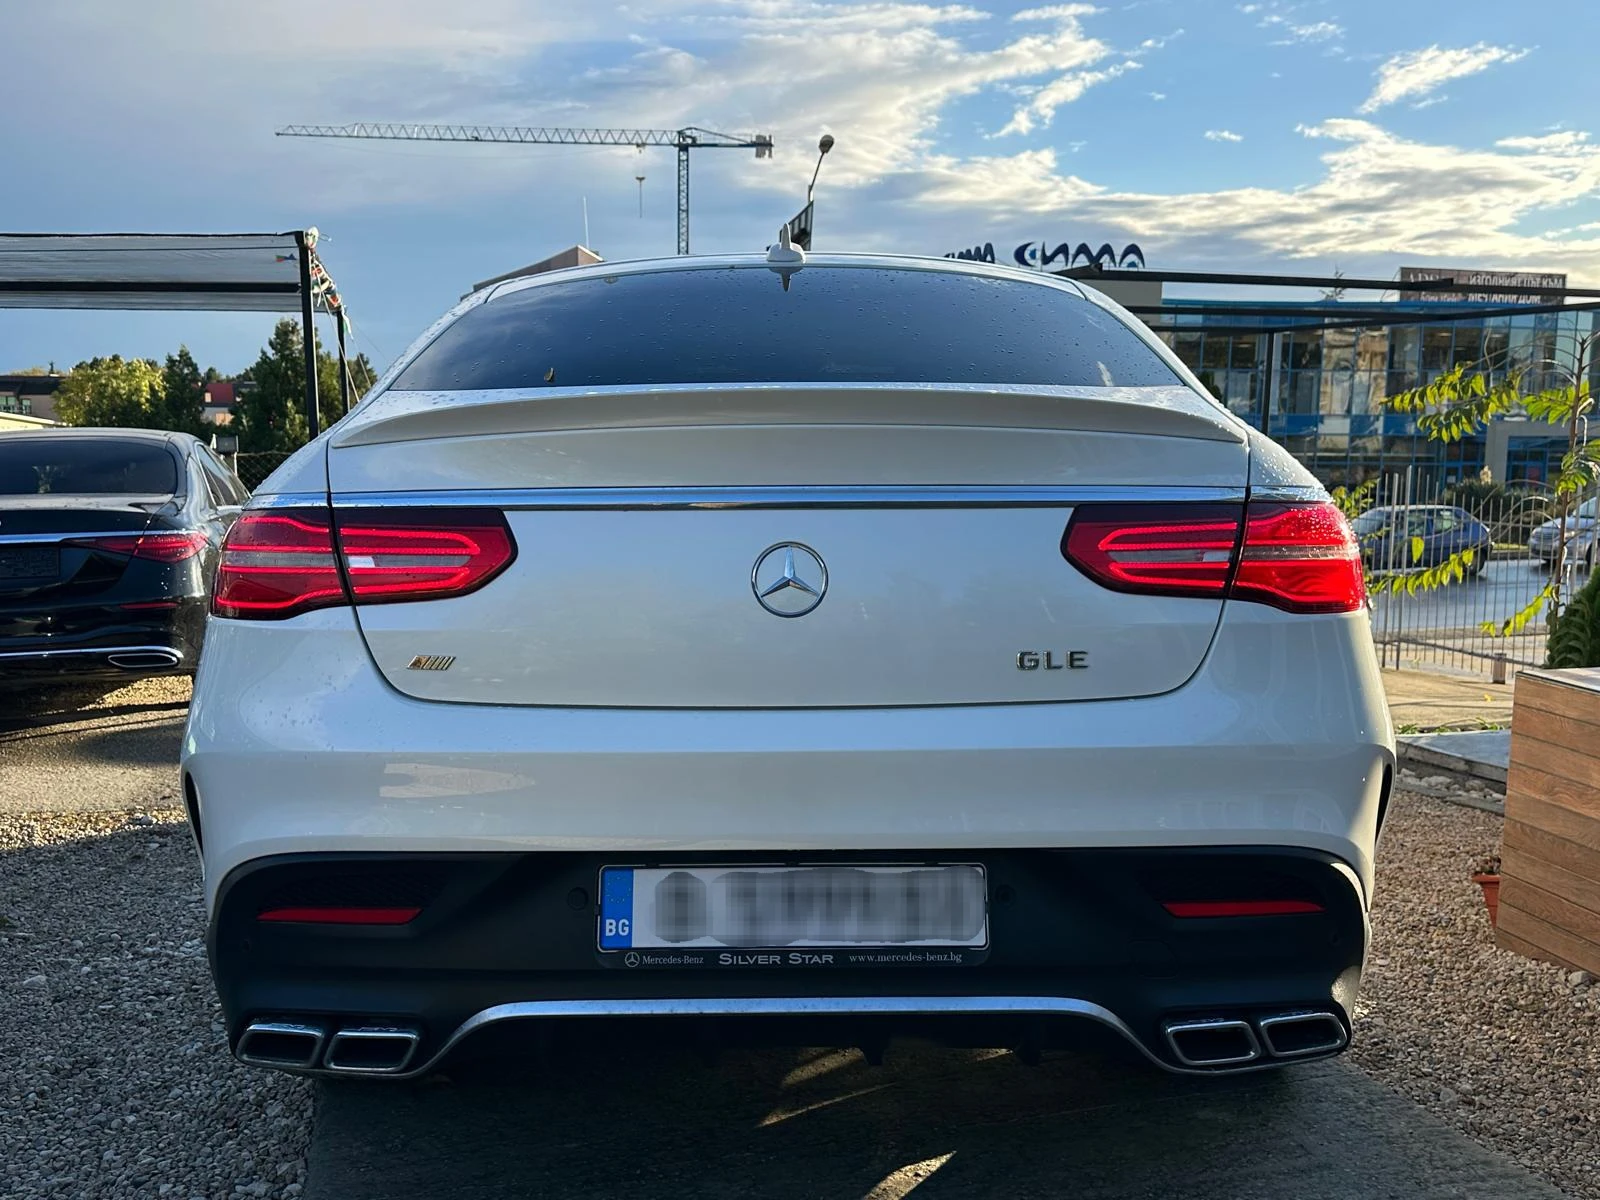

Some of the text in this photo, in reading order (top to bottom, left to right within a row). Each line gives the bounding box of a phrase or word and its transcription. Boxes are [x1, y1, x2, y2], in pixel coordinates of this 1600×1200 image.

[1016, 650, 1090, 671] GLE
[605, 918, 630, 937] BG
[642, 952, 962, 965] Mercedes-Benz SILVER STAR www.mercedes-benz.bg
